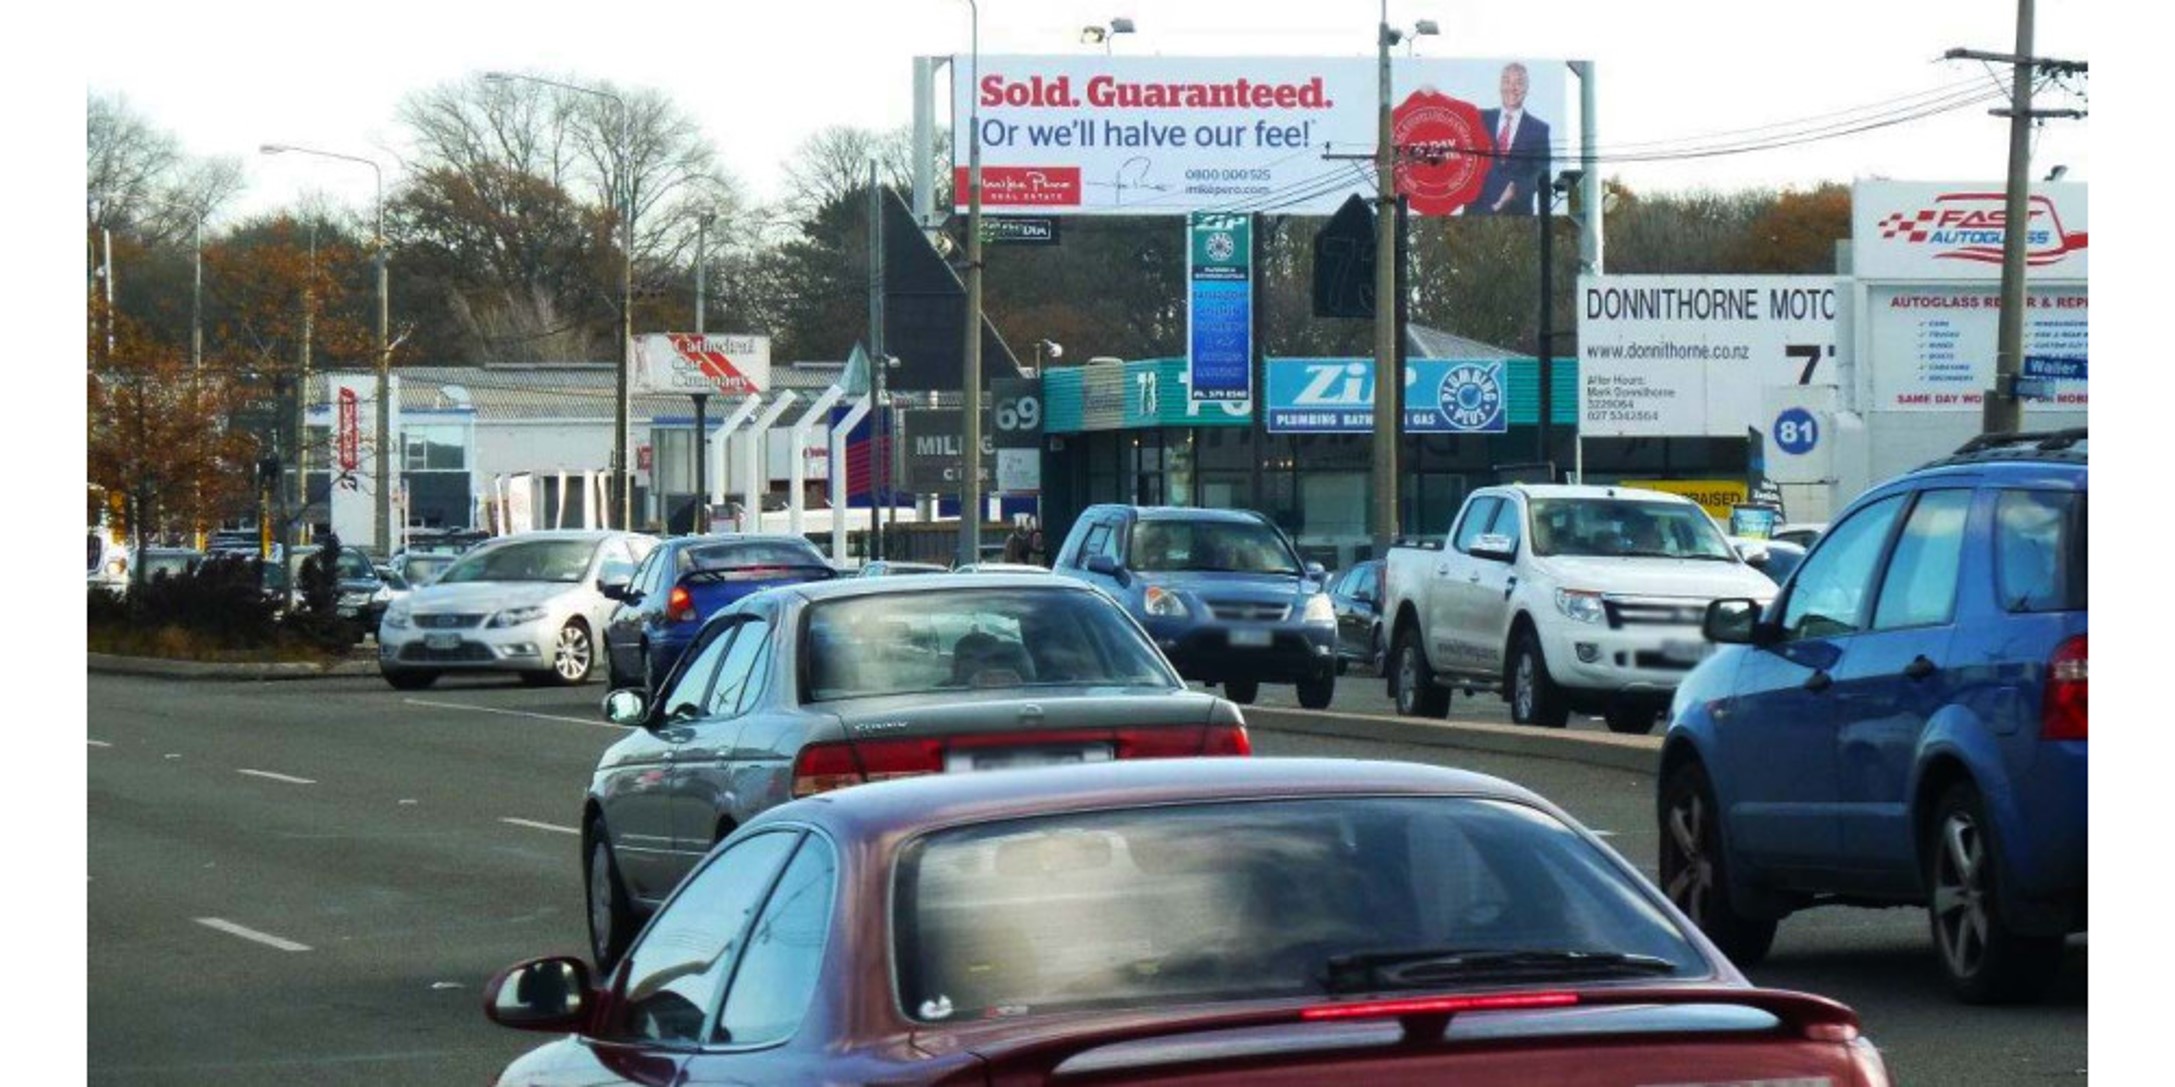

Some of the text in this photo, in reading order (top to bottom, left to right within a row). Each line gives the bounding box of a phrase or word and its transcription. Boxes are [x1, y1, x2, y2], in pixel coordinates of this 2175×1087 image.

[980, 75, 1333, 108] Sold. Guaranteed.
[982, 119, 1019, 147] Or
[1028, 119, 1095, 147] we'll
[1104, 119, 1186, 147] halve
[1195, 126, 1246, 147] our
[1930, 230, 2050, 244] AUTOGLSS
[1587, 288, 1759, 320] DONNITHORNE
[1891, 297, 1980, 308] AUTOGLASS
[1587, 342, 1750, 360] www.donnithorne.co.nz
[1441, 369, 1498, 401] PLUMBING
[1897, 395, 1931, 404] SAME
[1935, 395, 1958, 404] DAY
[996, 397, 1041, 431] 69
[1276, 413, 1337, 425] PLUMBING
[1413, 413, 1436, 425] GAS
[1452, 408, 1487, 425] PLUS
[1780, 421, 1813, 443] 81
